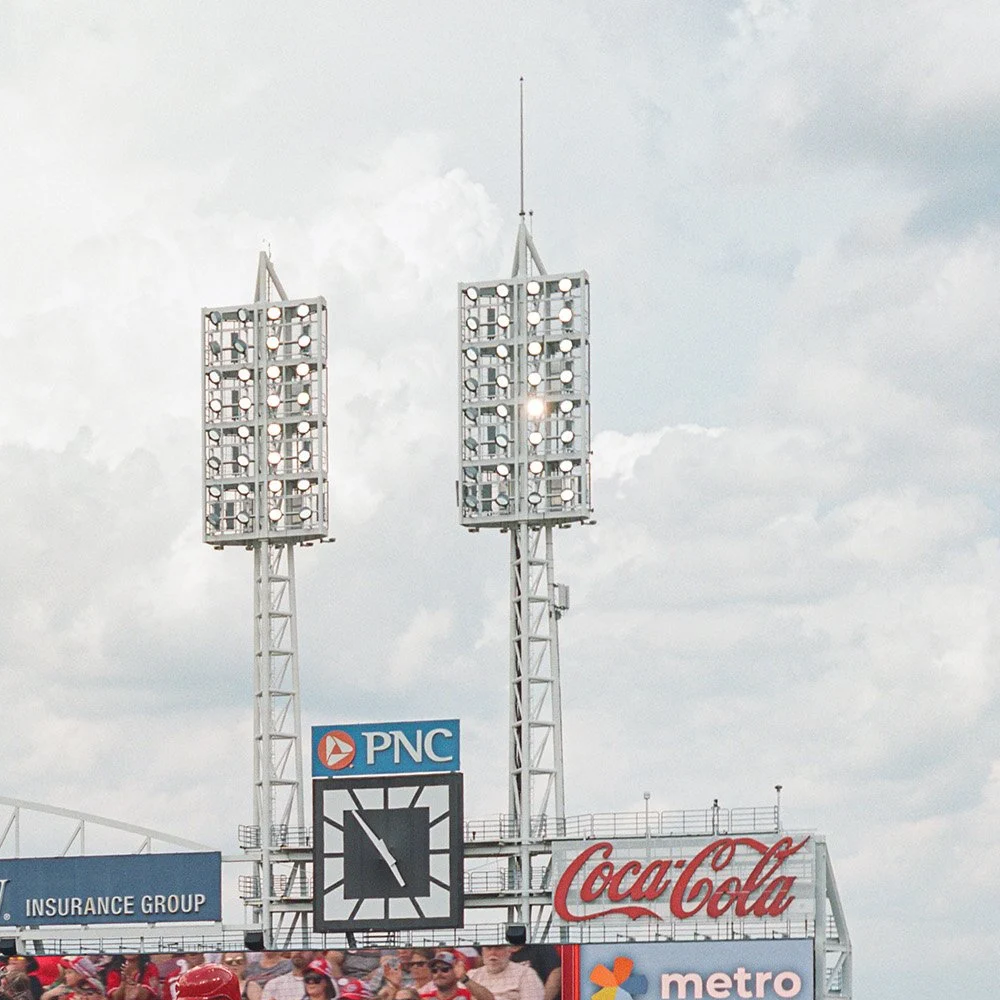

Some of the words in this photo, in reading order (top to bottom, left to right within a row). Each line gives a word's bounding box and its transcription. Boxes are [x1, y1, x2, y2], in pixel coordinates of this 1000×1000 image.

[361, 728, 453, 765] PNC
[553, 835, 811, 922] Coca-Cola
[26, 896, 135, 917] INSURANCE
[141, 894, 207, 914] GROUP
[661, 967, 802, 1000] metro
